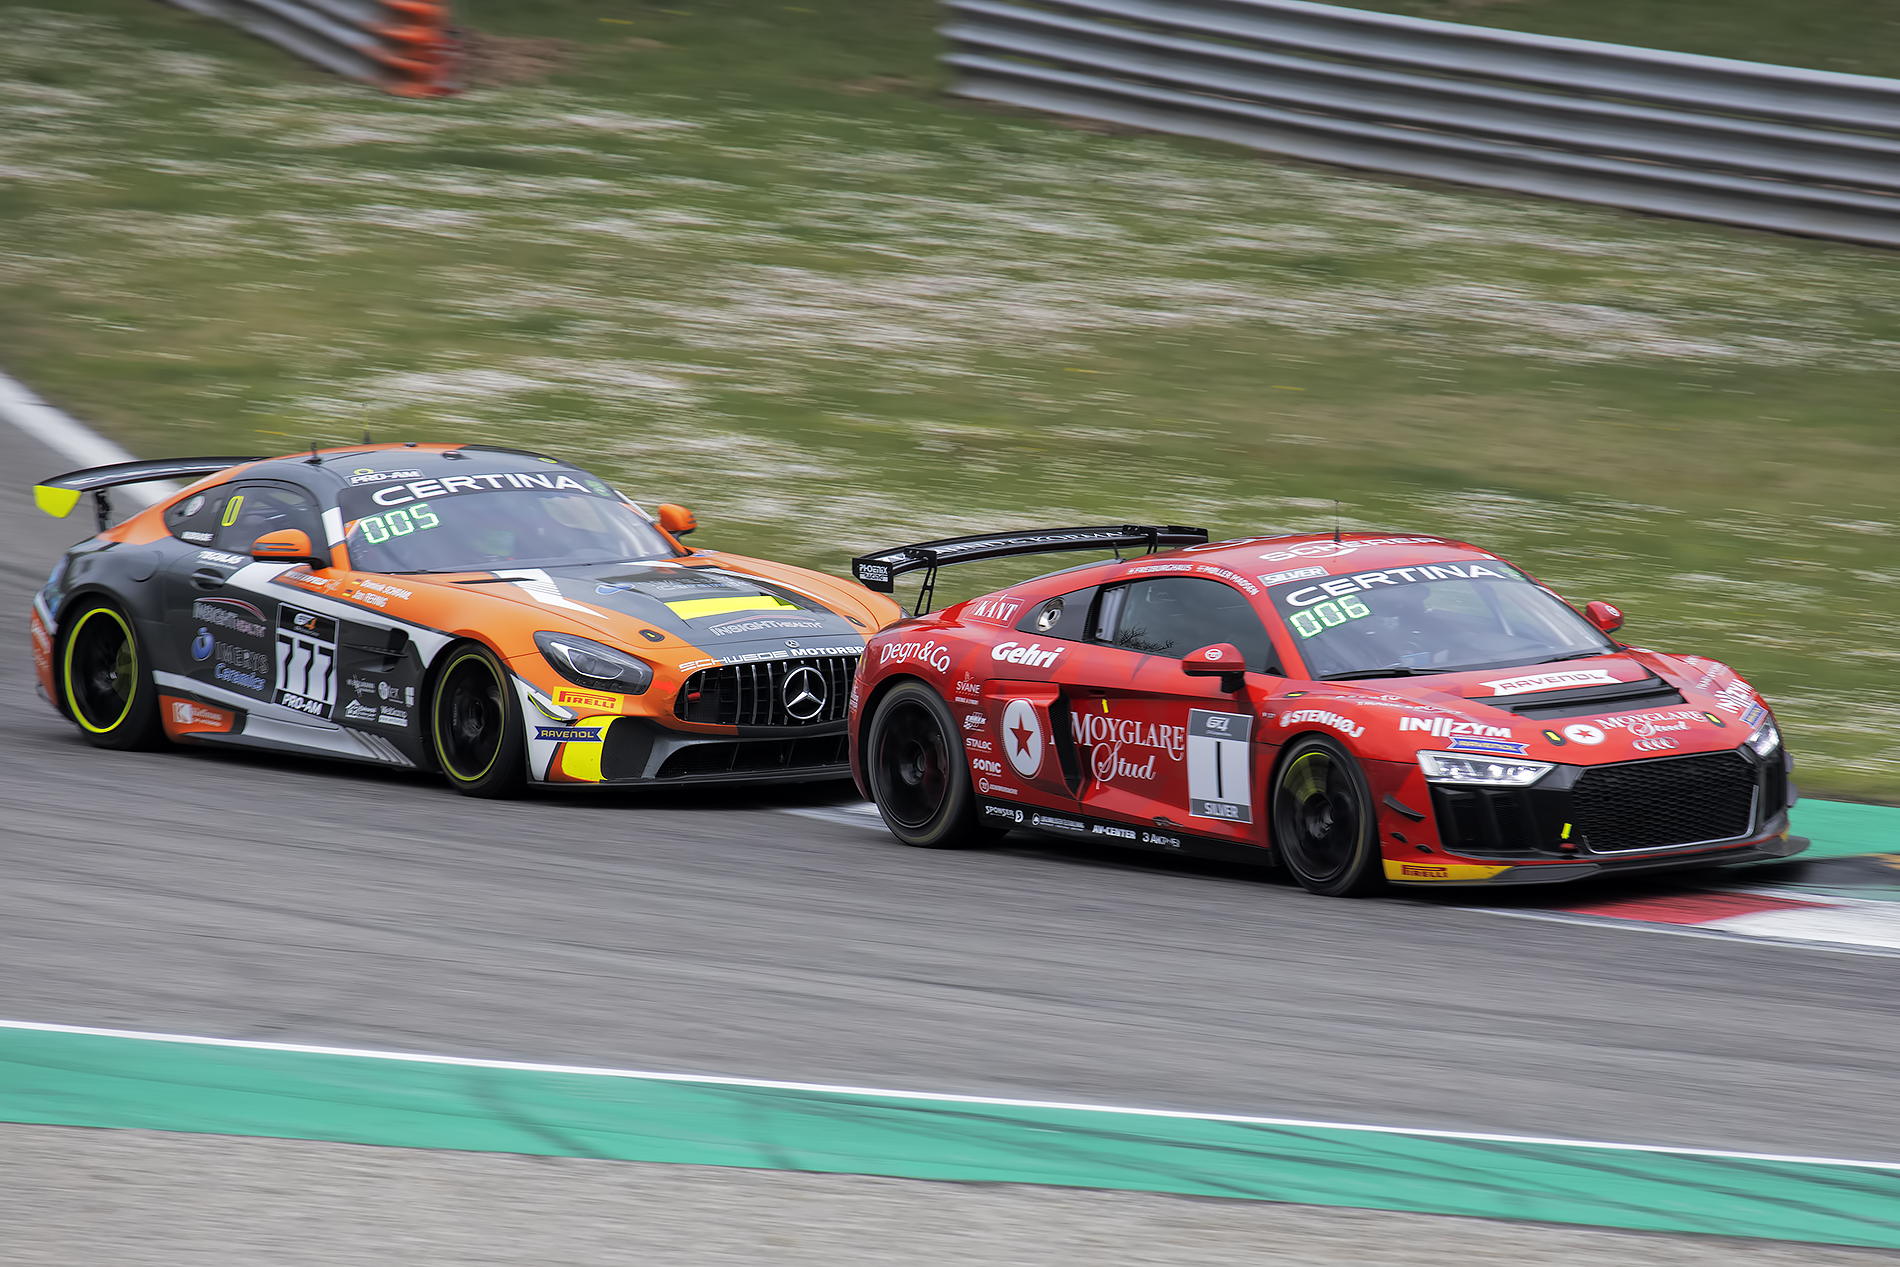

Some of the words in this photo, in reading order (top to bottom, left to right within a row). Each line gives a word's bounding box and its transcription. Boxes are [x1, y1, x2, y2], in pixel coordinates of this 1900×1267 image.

[372, 473, 592, 506] CERTINA
[359, 503, 439, 544] 005
[1264, 567, 1324, 585] SILVER
[1285, 564, 1507, 607] CERTINA
[973, 600, 1019, 621] KANT
[1289, 594, 1371, 638] 006
[678, 650, 789, 672] SCHWEDE
[880, 640, 951, 674] Degn&Co.
[991, 641, 1066, 668] Gehri
[214, 662, 267, 691] Ceramics
[277, 634, 336, 702] 777
[956, 681, 981, 694] SVANE
[1500, 672, 1601, 690] RAVENOL
[282, 693, 323, 716] PRO-AM
[559, 691, 617, 709] PIRELLI
[1289, 709, 1365, 738] STENHØJ
[1594, 710, 1709, 730] MOYGLARE
[541, 730, 594, 738] RAVENOL
[1071, 712, 1185, 761] MOYGLARE
[973, 758, 1001, 773] SONIC
[1091, 740, 1157, 790] Stud
[1215, 741, 1223, 798] 1
[985, 806, 1015, 817] SPONSER
[1204, 803, 1239, 818] SILVER
[1402, 865, 1448, 878] PIRELLI
